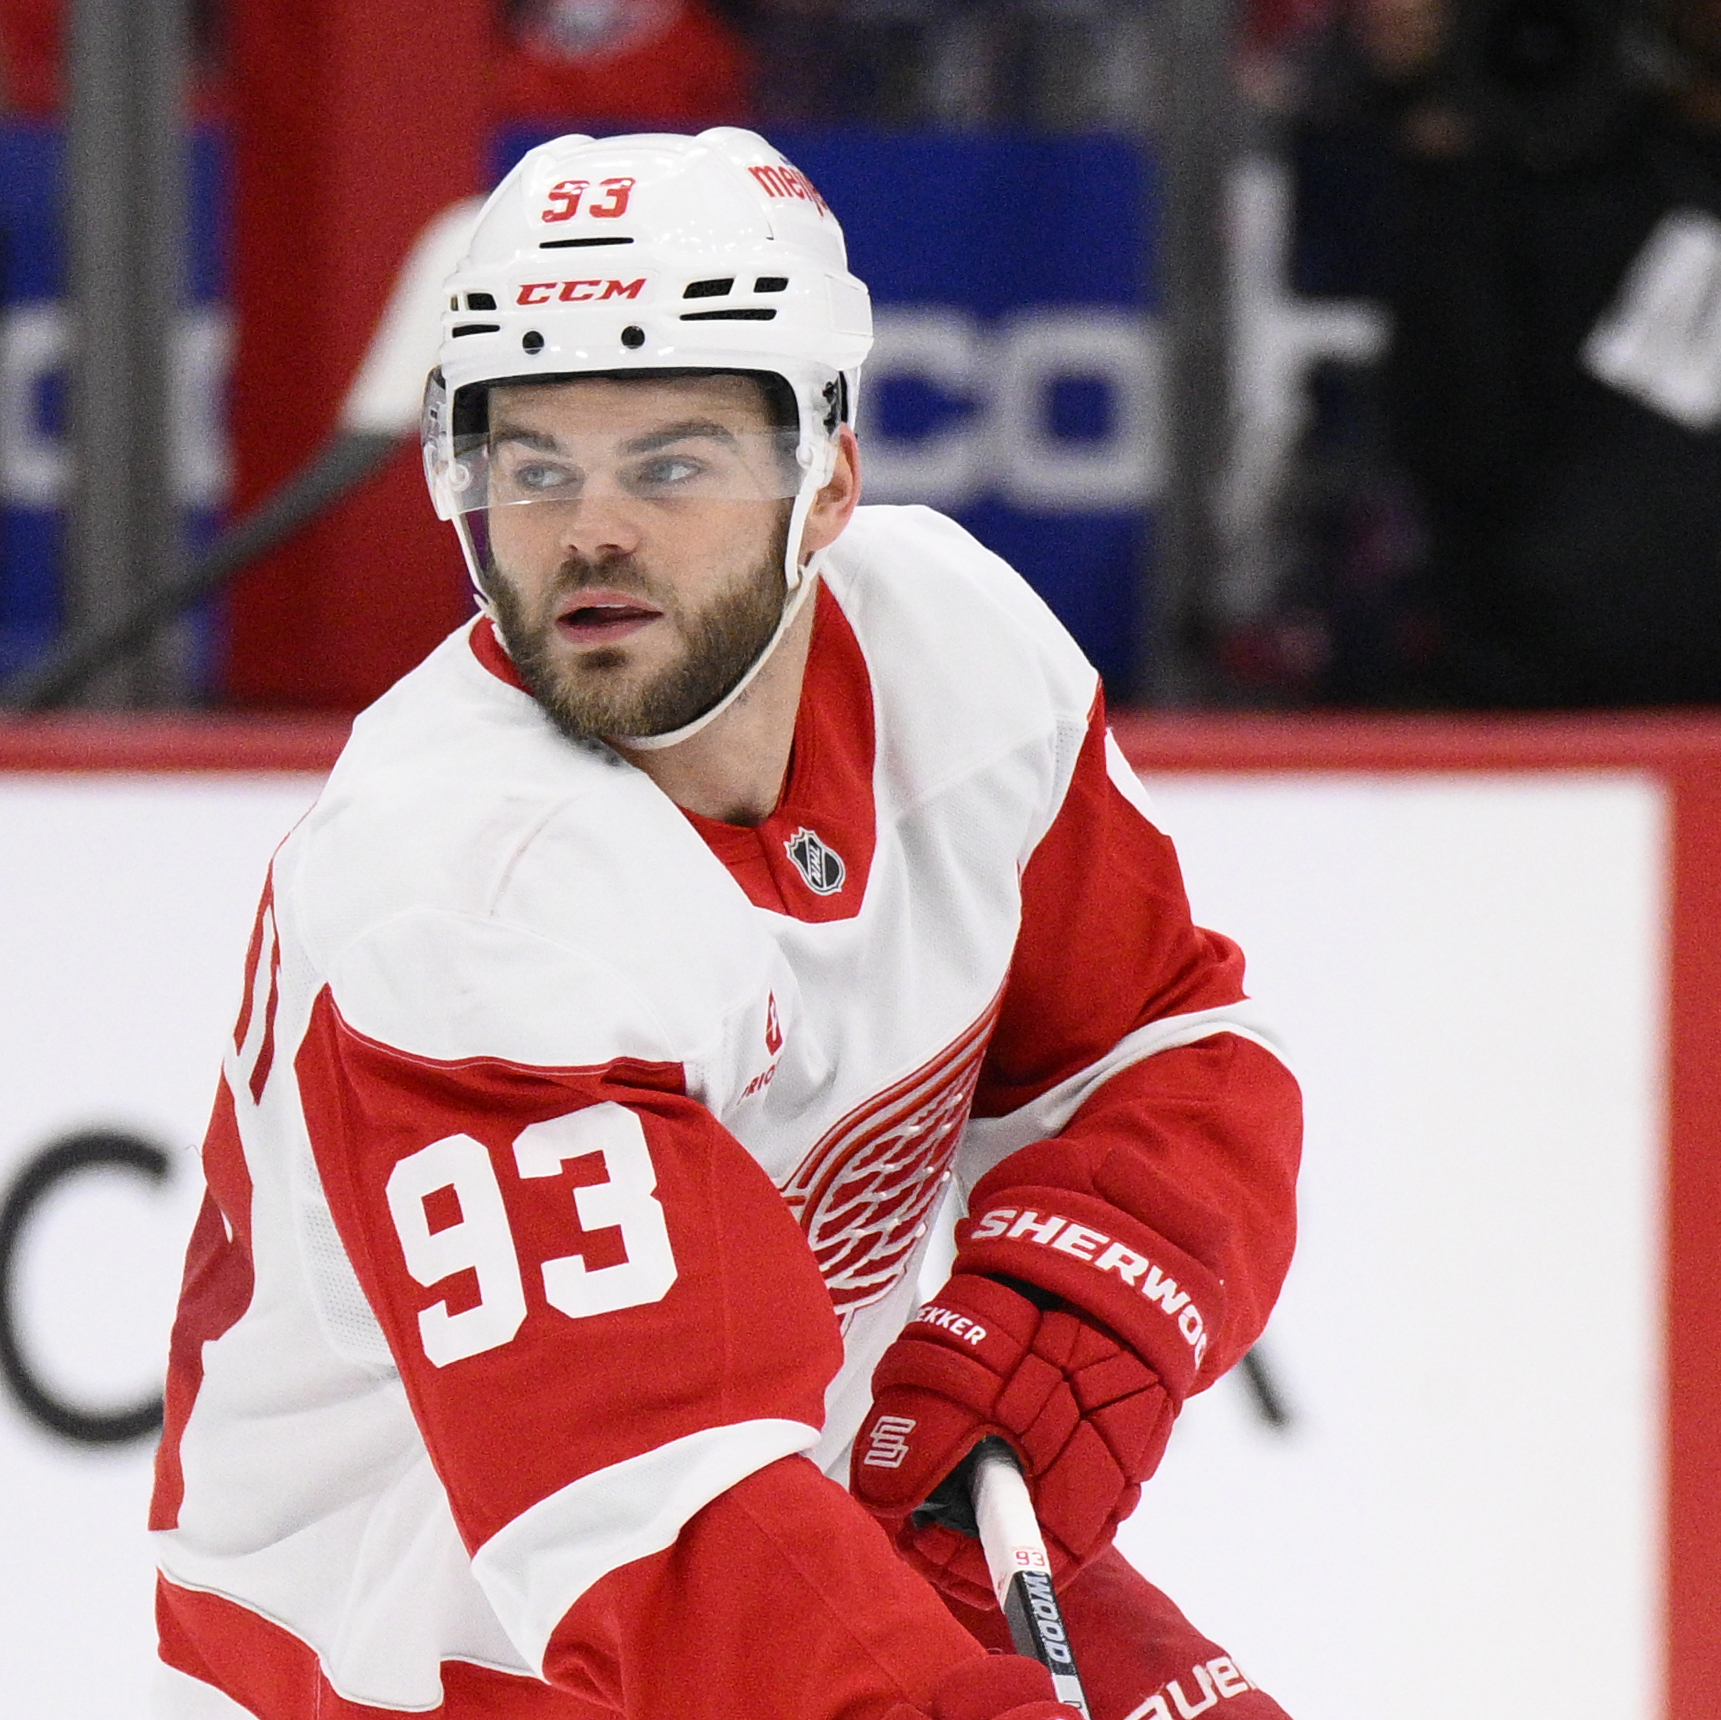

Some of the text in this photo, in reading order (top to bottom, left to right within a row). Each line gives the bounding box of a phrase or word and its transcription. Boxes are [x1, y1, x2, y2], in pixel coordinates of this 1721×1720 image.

[541, 177, 636, 223] 93
[515, 278, 647, 306] CCM
[384, 1100, 679, 1369] 93
[1014, 1550, 1046, 1567] 93
